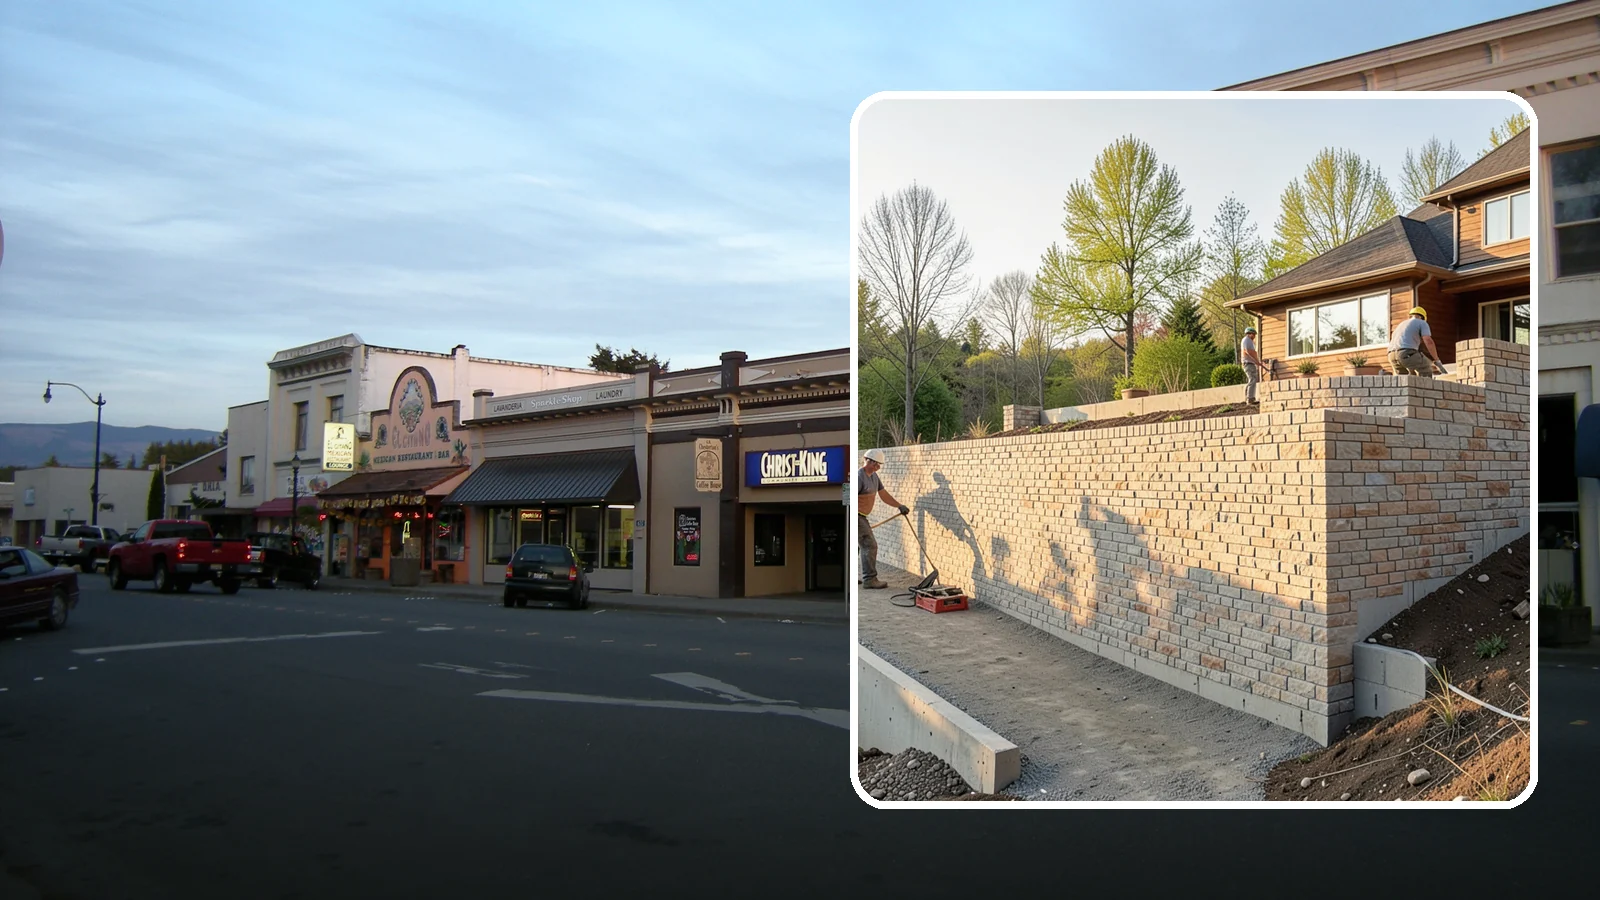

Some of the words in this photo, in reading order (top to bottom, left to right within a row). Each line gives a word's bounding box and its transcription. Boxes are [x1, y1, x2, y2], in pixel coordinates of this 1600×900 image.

[493, 402, 522, 413] LAVANDERIA
[561, 394, 583, 405] Shop
[595, 389, 624, 400] LAUNDRY
[373, 455, 396, 464] MEXICAN
[397, 451, 434, 462] RESTAURANT
[438, 450, 450, 459] BAR
[760, 452, 798, 478] CHRIST
[798, 450, 828, 477] KING
